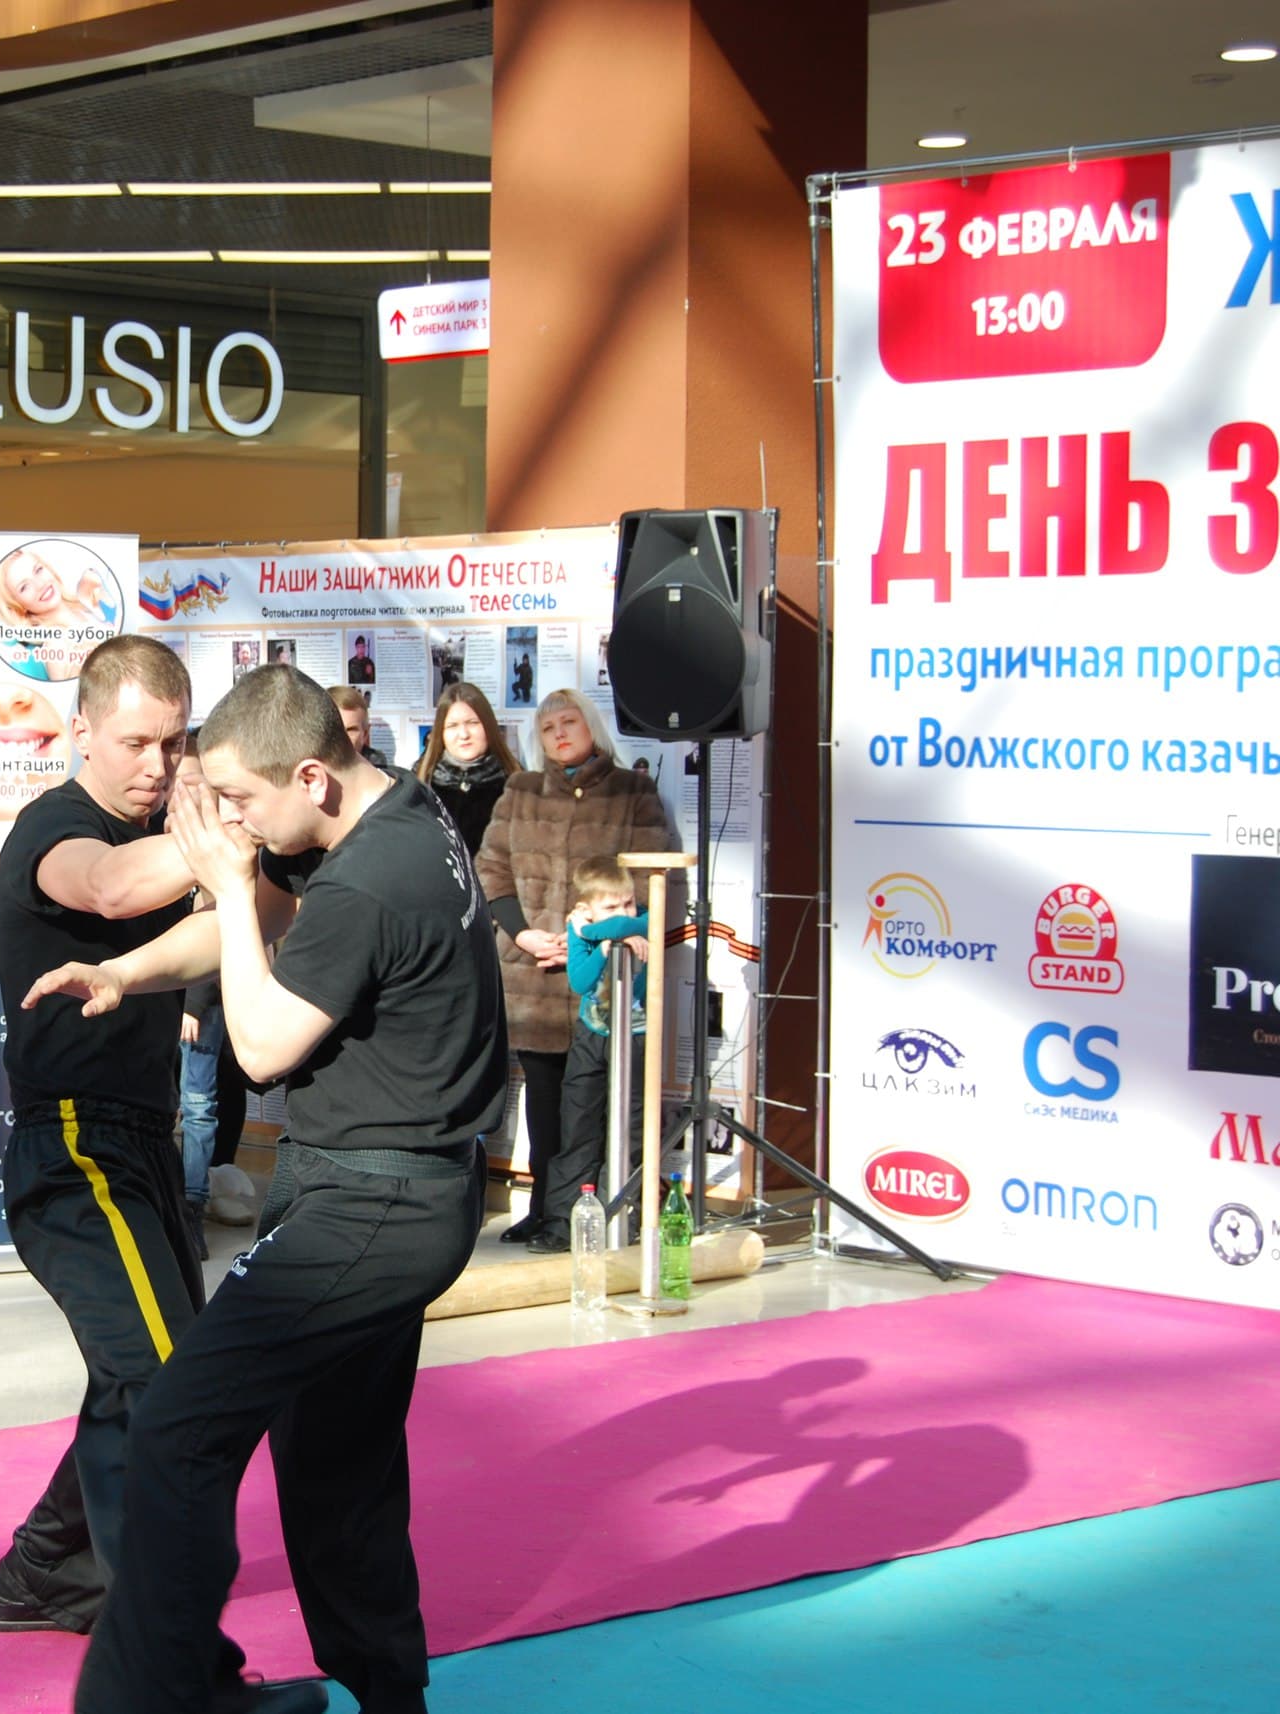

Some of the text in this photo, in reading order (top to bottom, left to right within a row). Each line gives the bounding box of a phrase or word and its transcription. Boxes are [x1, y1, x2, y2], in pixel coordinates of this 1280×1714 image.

[886, 198, 1158, 267] 23 ФЕВРАЛЯ
[413, 302, 456, 318] ДЕТСКИЙ
[458, 300, 479, 313] МИР
[971, 290, 1065, 336] 13:00
[413, 321, 452, 336] СИНЕМА
[454, 319, 479, 332] ПАРК
[870, 430, 1170, 605] ДЕНЬ
[261, 607, 319, 619] Фотовыставка
[320, 606, 376, 620] подготовлена
[428, 605, 465, 618] журнала
[470, 593, 557, 613] телесемь
[68, 626, 115, 643] зубов
[13, 651, 28, 660] от
[34, 650, 64, 660] 1000
[870, 645, 1124, 692] праздничная
[869, 735, 908, 767] от
[918, 717, 1130, 771] Волжского
[1226, 814, 1280, 855] Гене
[1038, 885, 1115, 939] BURGER
[885, 920, 925, 936] ОРТО
[886, 937, 998, 962] КОМФОРТ
[1041, 963, 1112, 984] STAND
[1023, 1020, 1121, 1102] CS
[1060, 1106, 1119, 1123] МЕДИКА
[871, 1164, 962, 1202] MIREL
